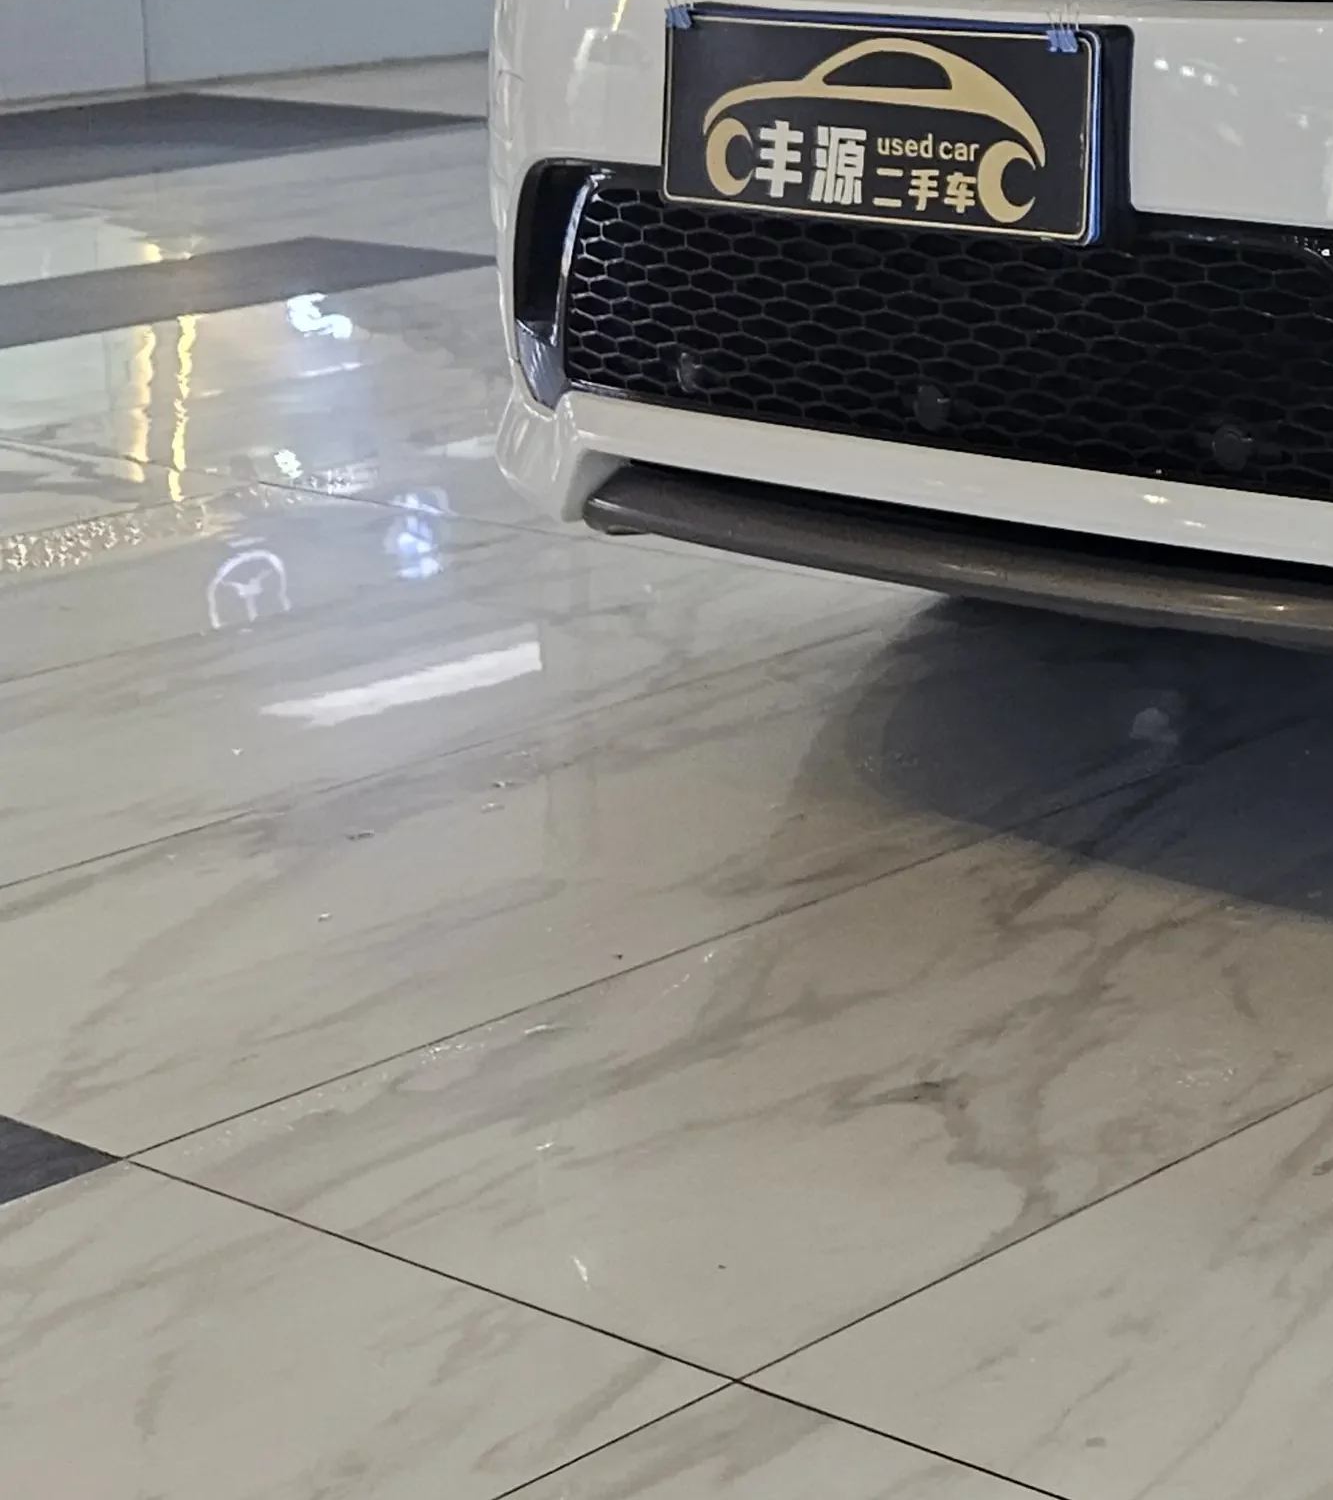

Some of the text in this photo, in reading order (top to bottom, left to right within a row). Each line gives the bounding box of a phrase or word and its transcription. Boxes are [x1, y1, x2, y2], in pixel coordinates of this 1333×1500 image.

[754, 119, 868, 206] 丰源
[876, 133, 980, 162] used car
[871, 168, 977, 214] 二手车
